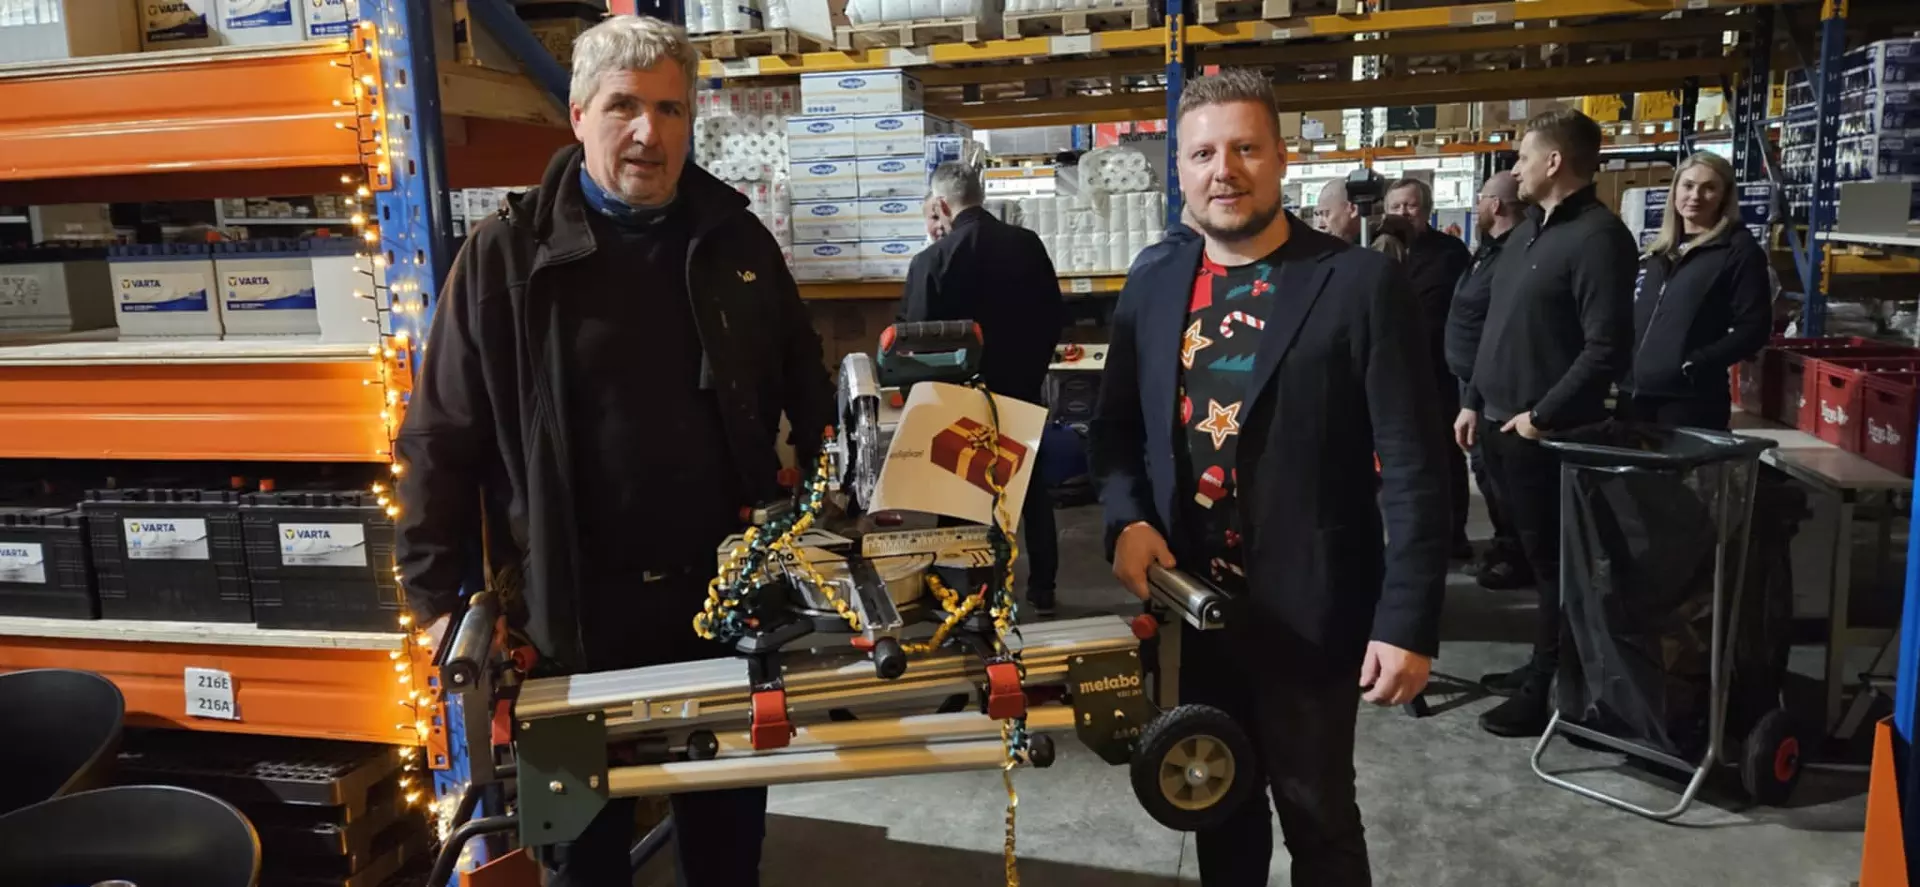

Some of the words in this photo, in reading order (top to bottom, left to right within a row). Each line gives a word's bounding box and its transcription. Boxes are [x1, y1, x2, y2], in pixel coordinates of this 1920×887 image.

[160, 3, 190, 14] VARTA
[132, 279, 161, 288] VARTA
[239, 276, 270, 286] VARTA
[142, 523, 176, 533] VARTA
[296, 529, 331, 539] VARTA
[198, 675, 229, 690] 216E
[1080, 674, 1140, 694] metabo
[198, 697, 230, 712] 216A
